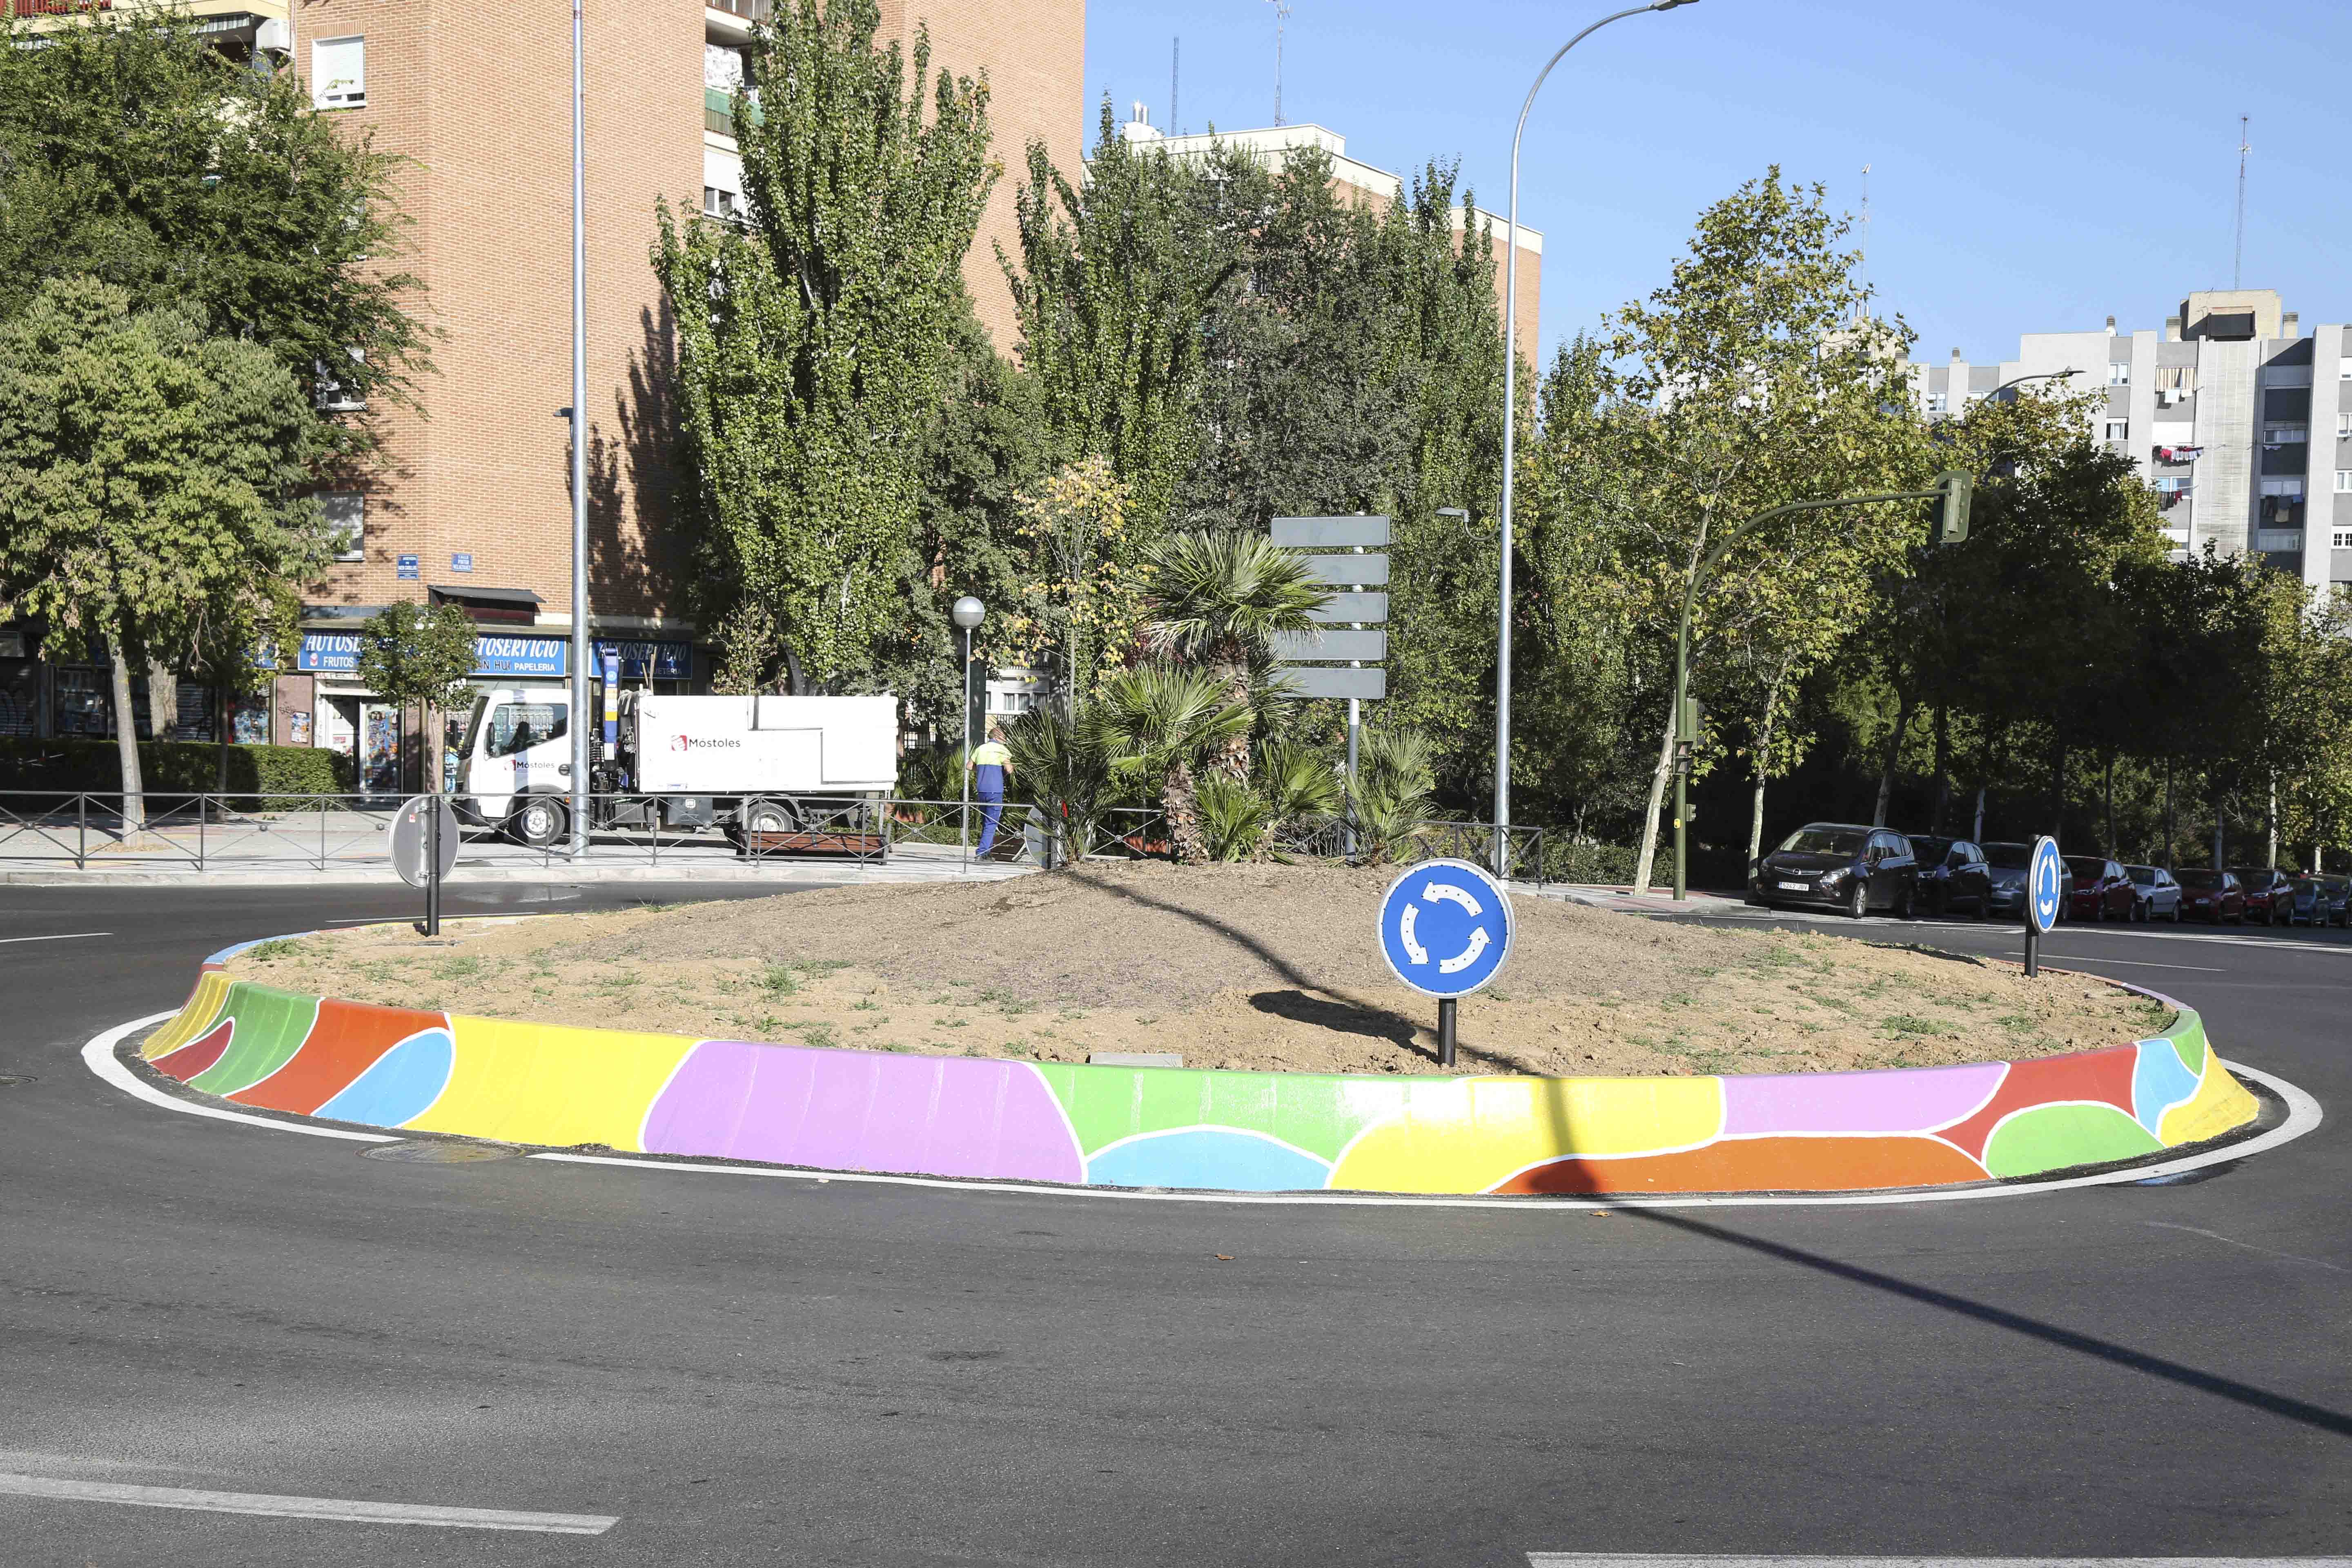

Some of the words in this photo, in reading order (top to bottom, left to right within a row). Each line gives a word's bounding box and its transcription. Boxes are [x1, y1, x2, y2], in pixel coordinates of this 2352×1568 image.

[305, 635, 363, 652] AUTOSE
[475, 638, 559, 658] TOSERVICIO
[323, 656, 354, 667] FRUTOS
[514, 662, 556, 672] PAPELERIA
[689, 737, 741, 748] Móstoles
[517, 760, 555, 769] Móstoles
